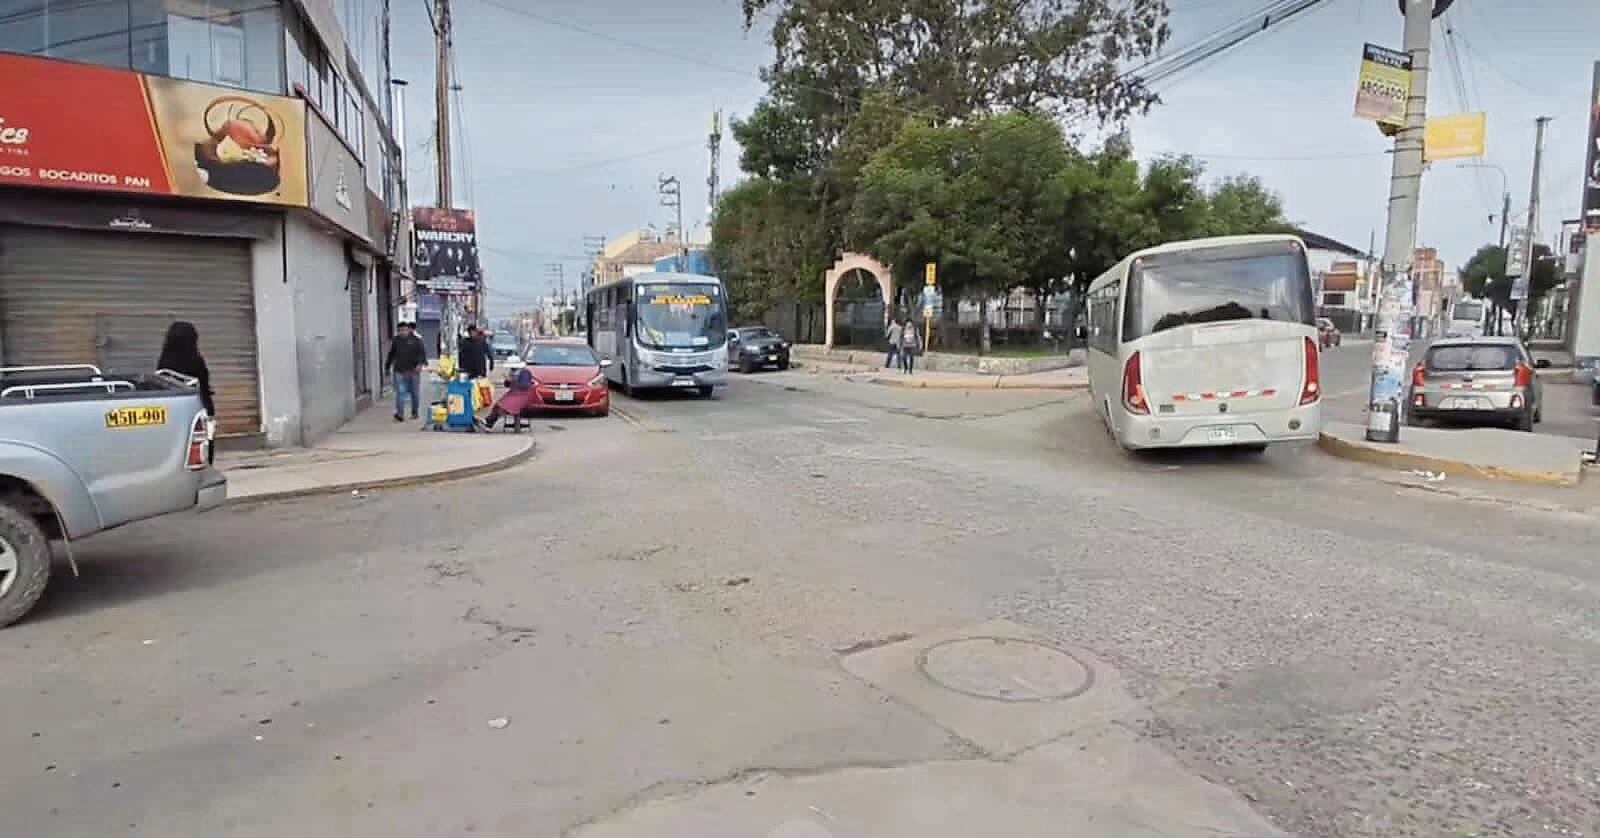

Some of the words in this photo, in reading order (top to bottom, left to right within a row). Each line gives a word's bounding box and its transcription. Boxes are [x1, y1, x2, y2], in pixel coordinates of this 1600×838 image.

[39, 168, 117, 184] BOCADITOS
[124, 175, 150, 187] PAN
[416, 229, 474, 243] WARCRY
